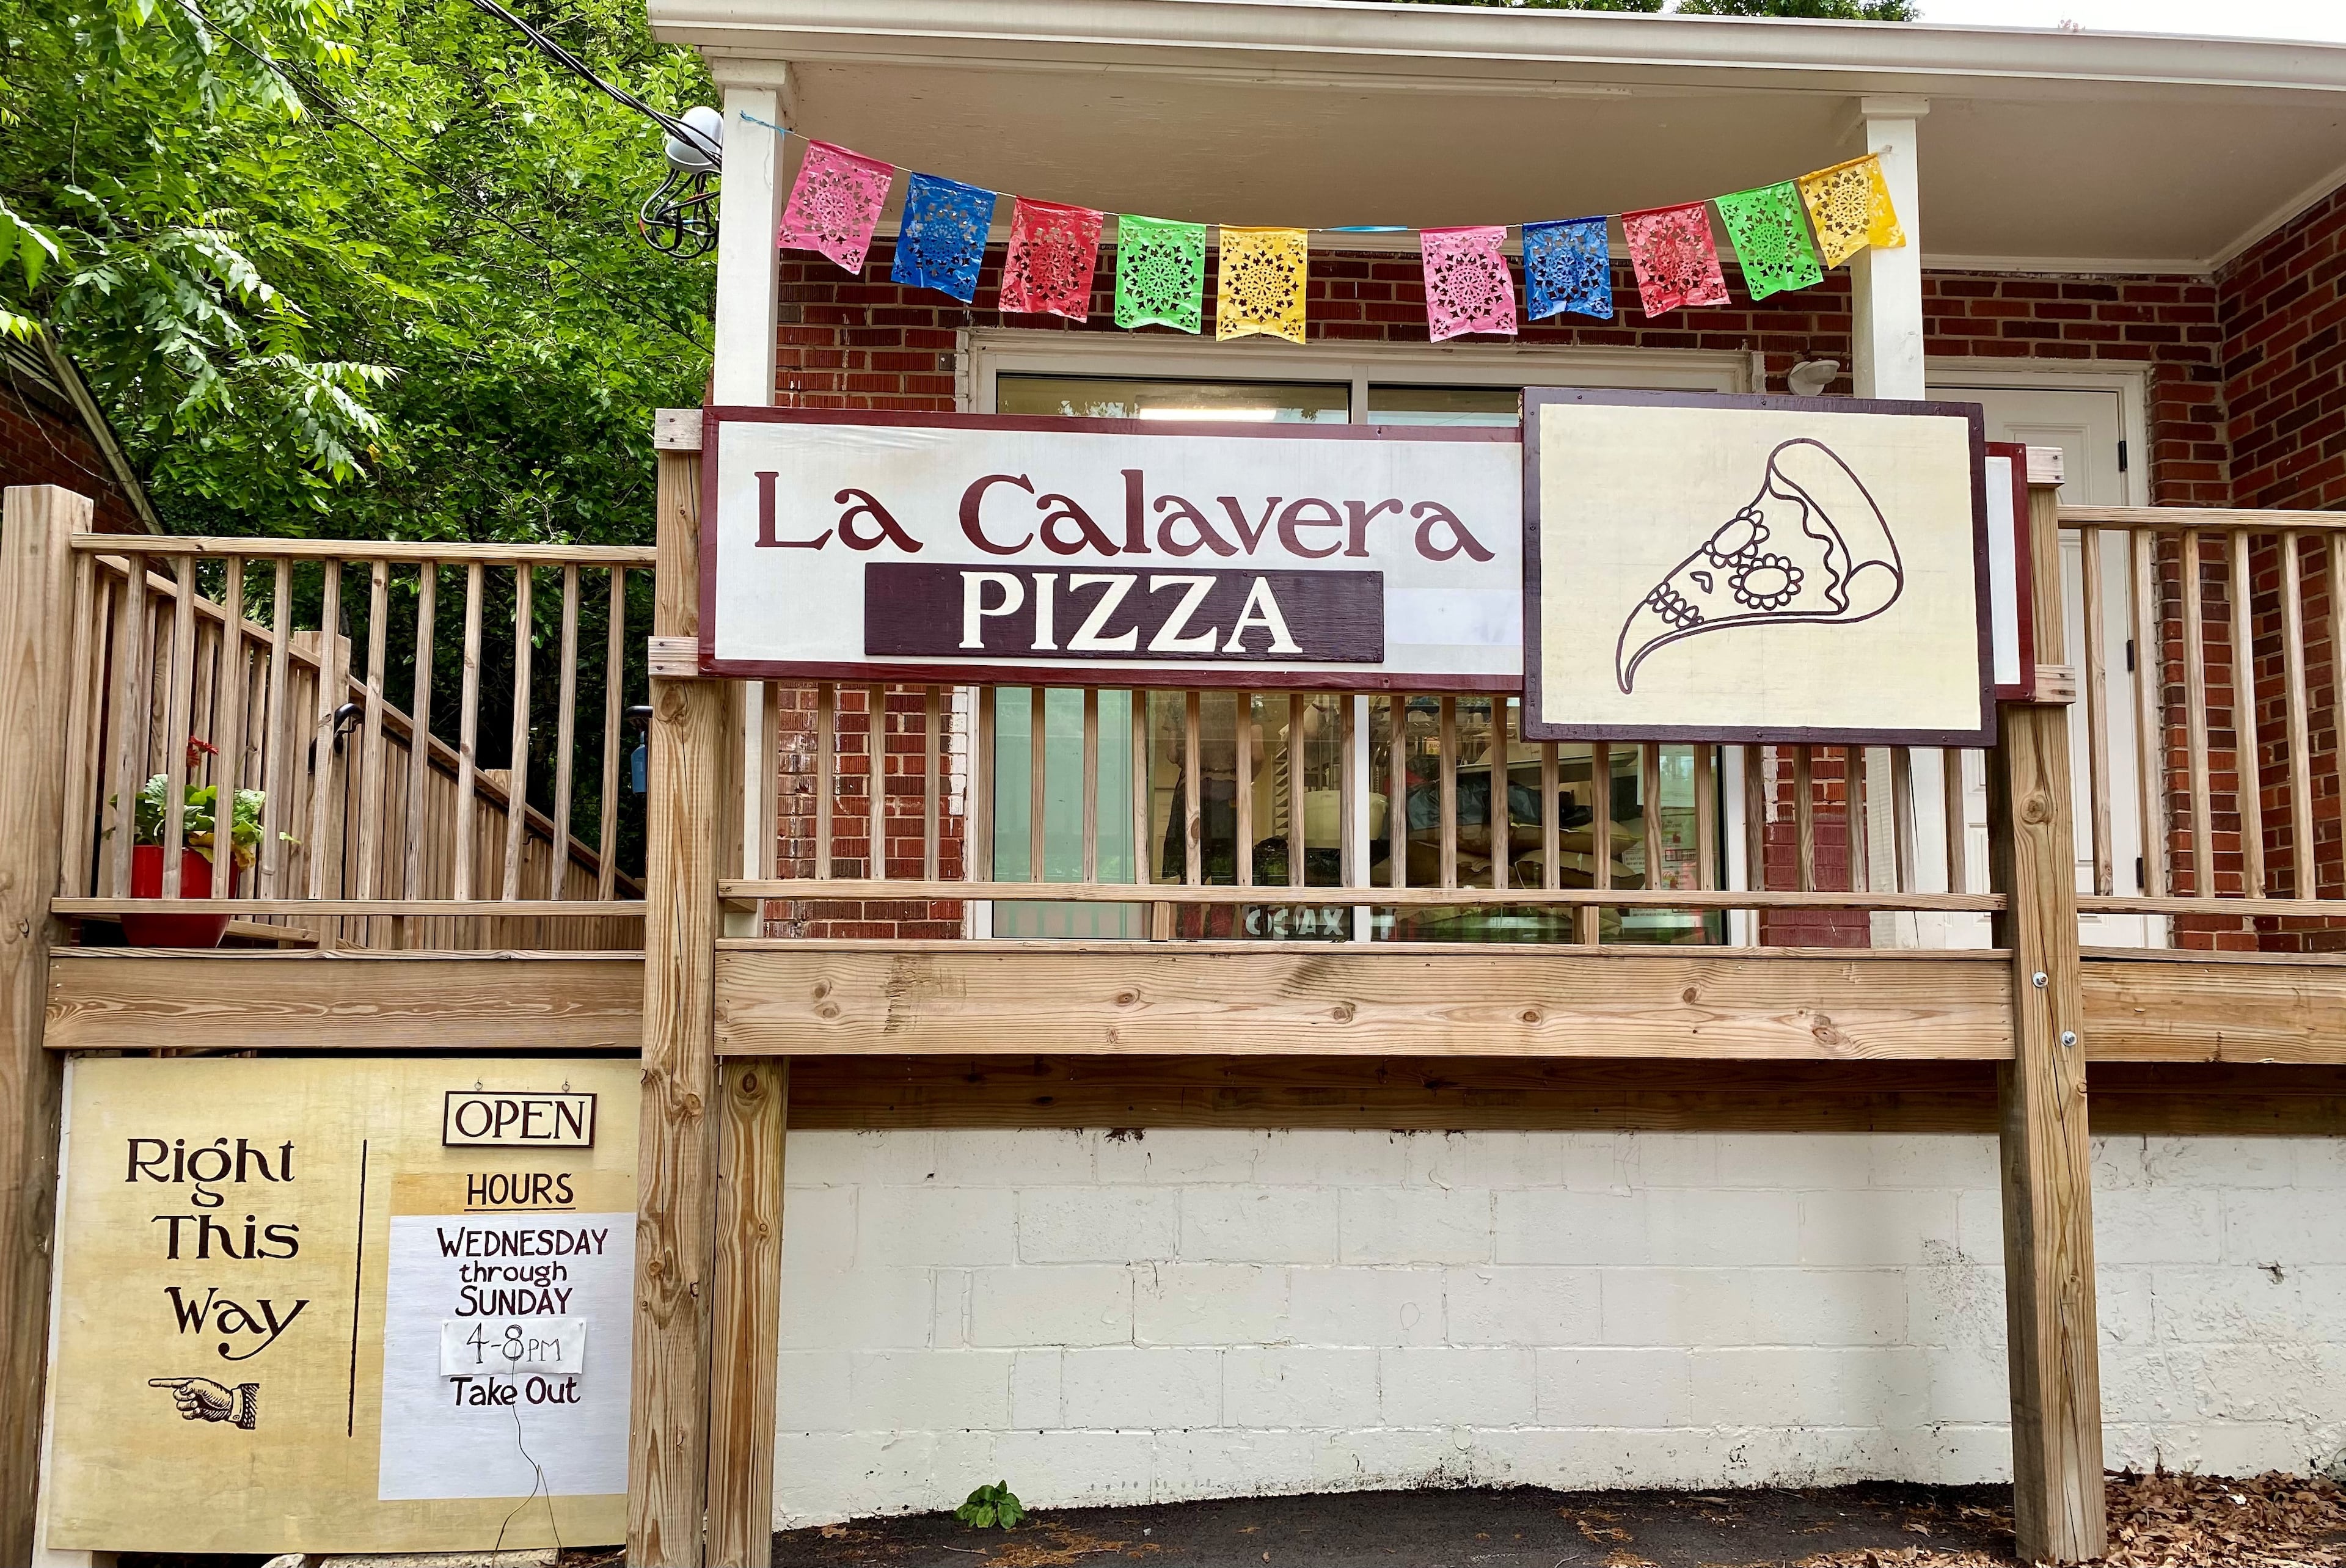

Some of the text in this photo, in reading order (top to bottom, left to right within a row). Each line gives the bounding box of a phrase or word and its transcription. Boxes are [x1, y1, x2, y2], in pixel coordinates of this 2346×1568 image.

[754, 469, 1496, 562] La Calavera
[958, 570, 1304, 654] PIZZA
[455, 1099, 585, 1140] OPEN
[125, 1137, 295, 1208] Right
[466, 1173, 574, 1205] HOURS
[151, 1214, 299, 1260] This
[436, 1227, 608, 1257] WEDNESDAY
[459, 1260, 568, 1288] through
[455, 1286, 573, 1317] SUNDAY
[164, 1286, 310, 1361] Way
[450, 1374, 581, 1407] Take Out
